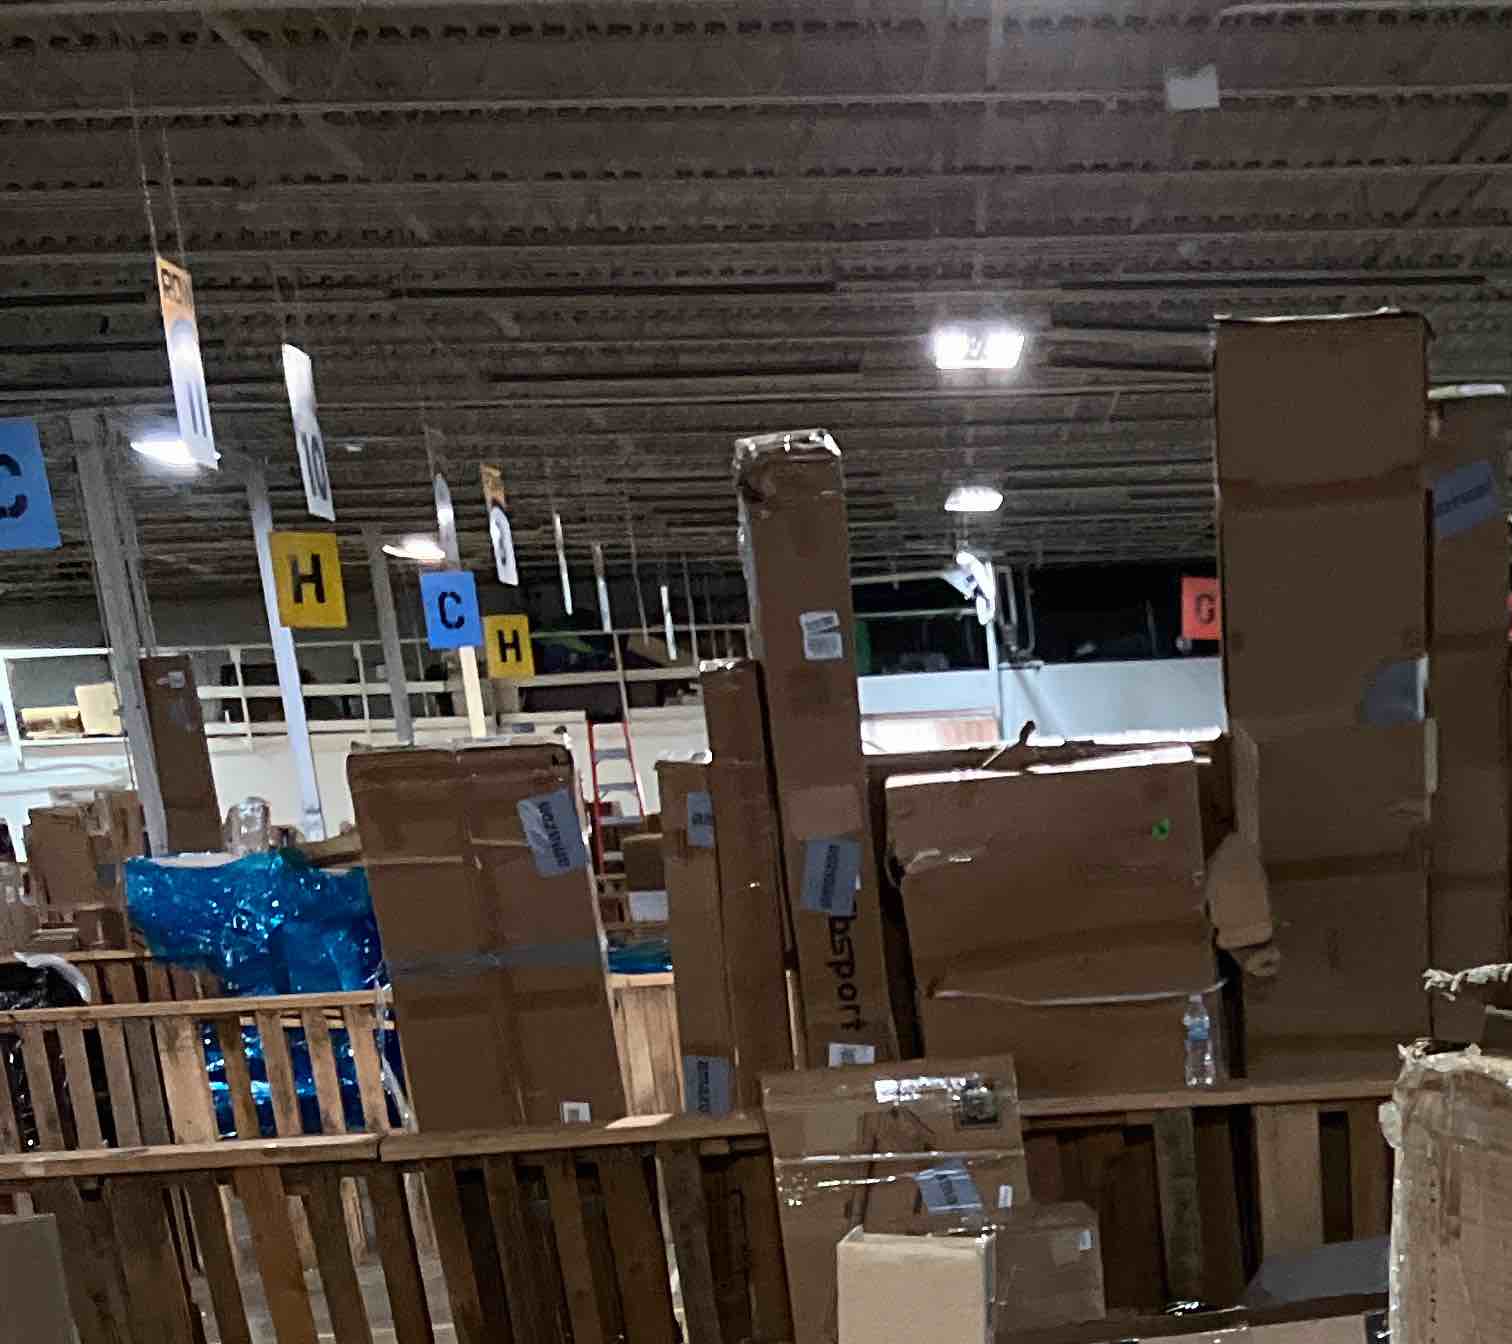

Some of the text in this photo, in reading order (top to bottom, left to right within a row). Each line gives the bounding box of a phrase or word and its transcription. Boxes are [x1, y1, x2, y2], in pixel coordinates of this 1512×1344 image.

[290, 553, 326, 606] H
[438, 591, 465, 630] C
[1193, 594, 1215, 623] G
[497, 629, 523, 663] H
